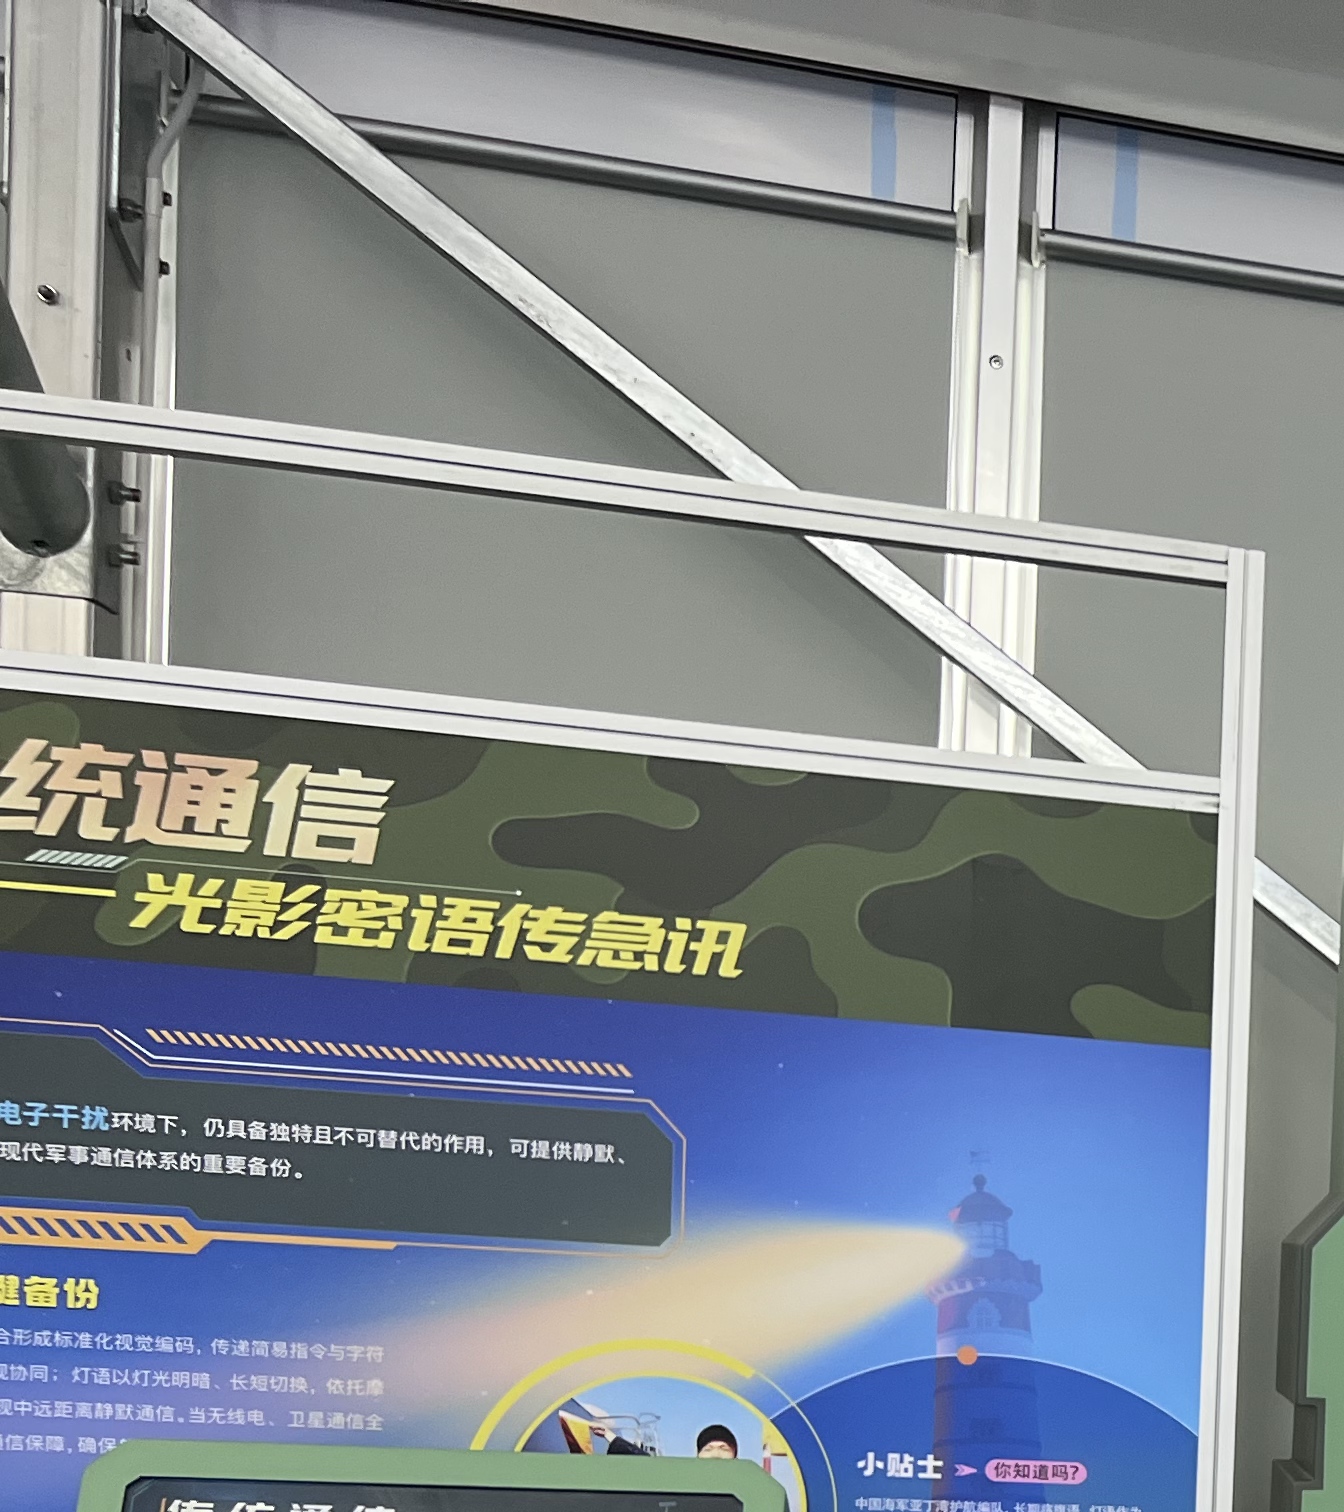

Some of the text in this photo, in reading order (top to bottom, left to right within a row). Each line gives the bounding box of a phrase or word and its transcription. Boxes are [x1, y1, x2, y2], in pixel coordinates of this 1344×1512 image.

[0, 738, 396, 866] 统通信
[857, 1451, 944, 1480] 小贴士
